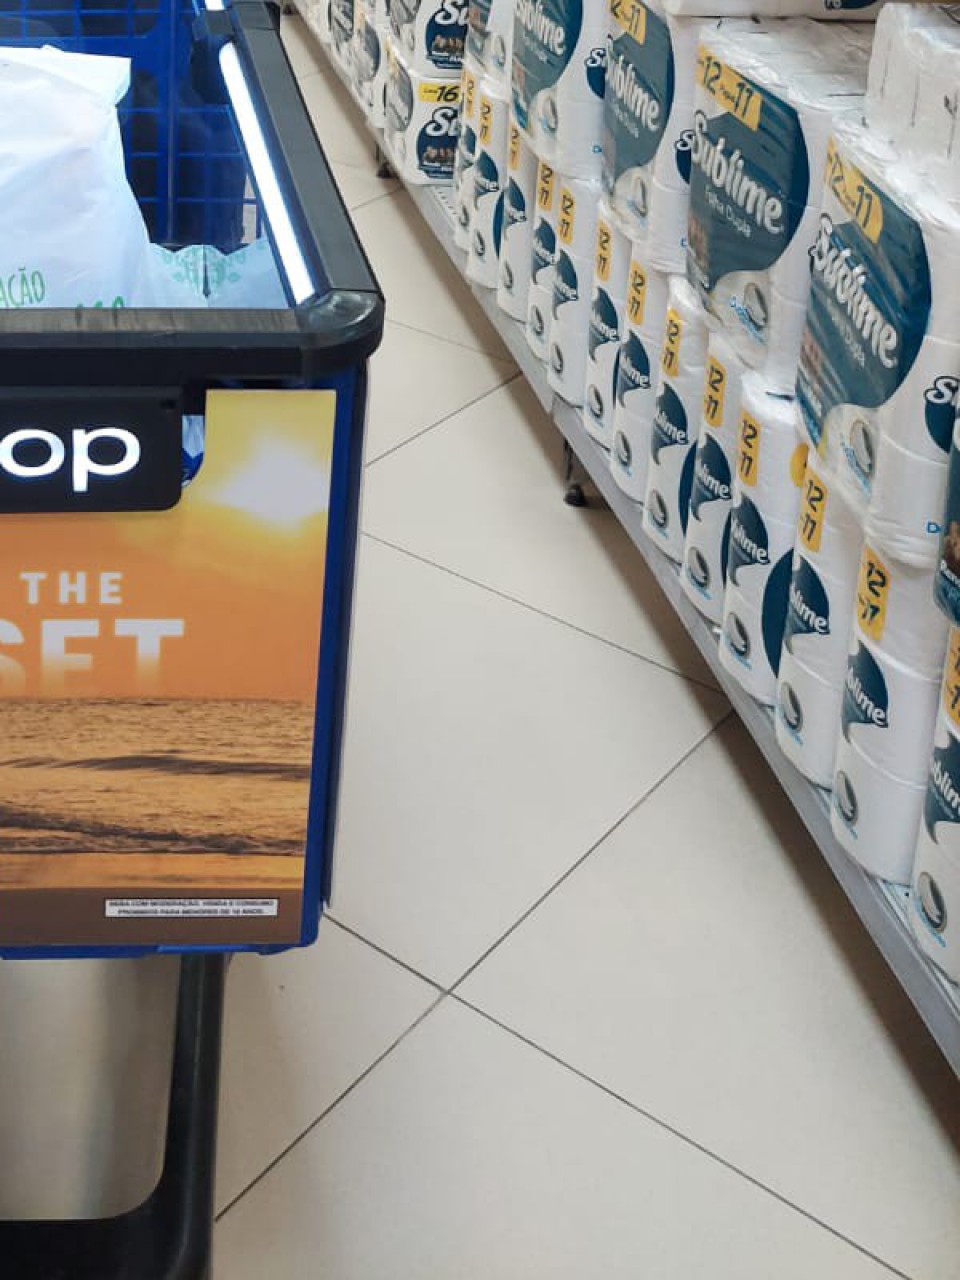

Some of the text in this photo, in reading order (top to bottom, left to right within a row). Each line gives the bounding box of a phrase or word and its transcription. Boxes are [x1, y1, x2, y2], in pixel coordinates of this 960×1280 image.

[436, 84, 460, 102] 16
[689, 109, 784, 235] Sublime
[808, 212, 899, 370] Sublime
[742, 420, 758, 450] 12
[806, 478, 825, 513] 12
[20, 571, 124, 605] THE
[866, 561, 888, 599] 12
[846, 664, 889, 728] blime
